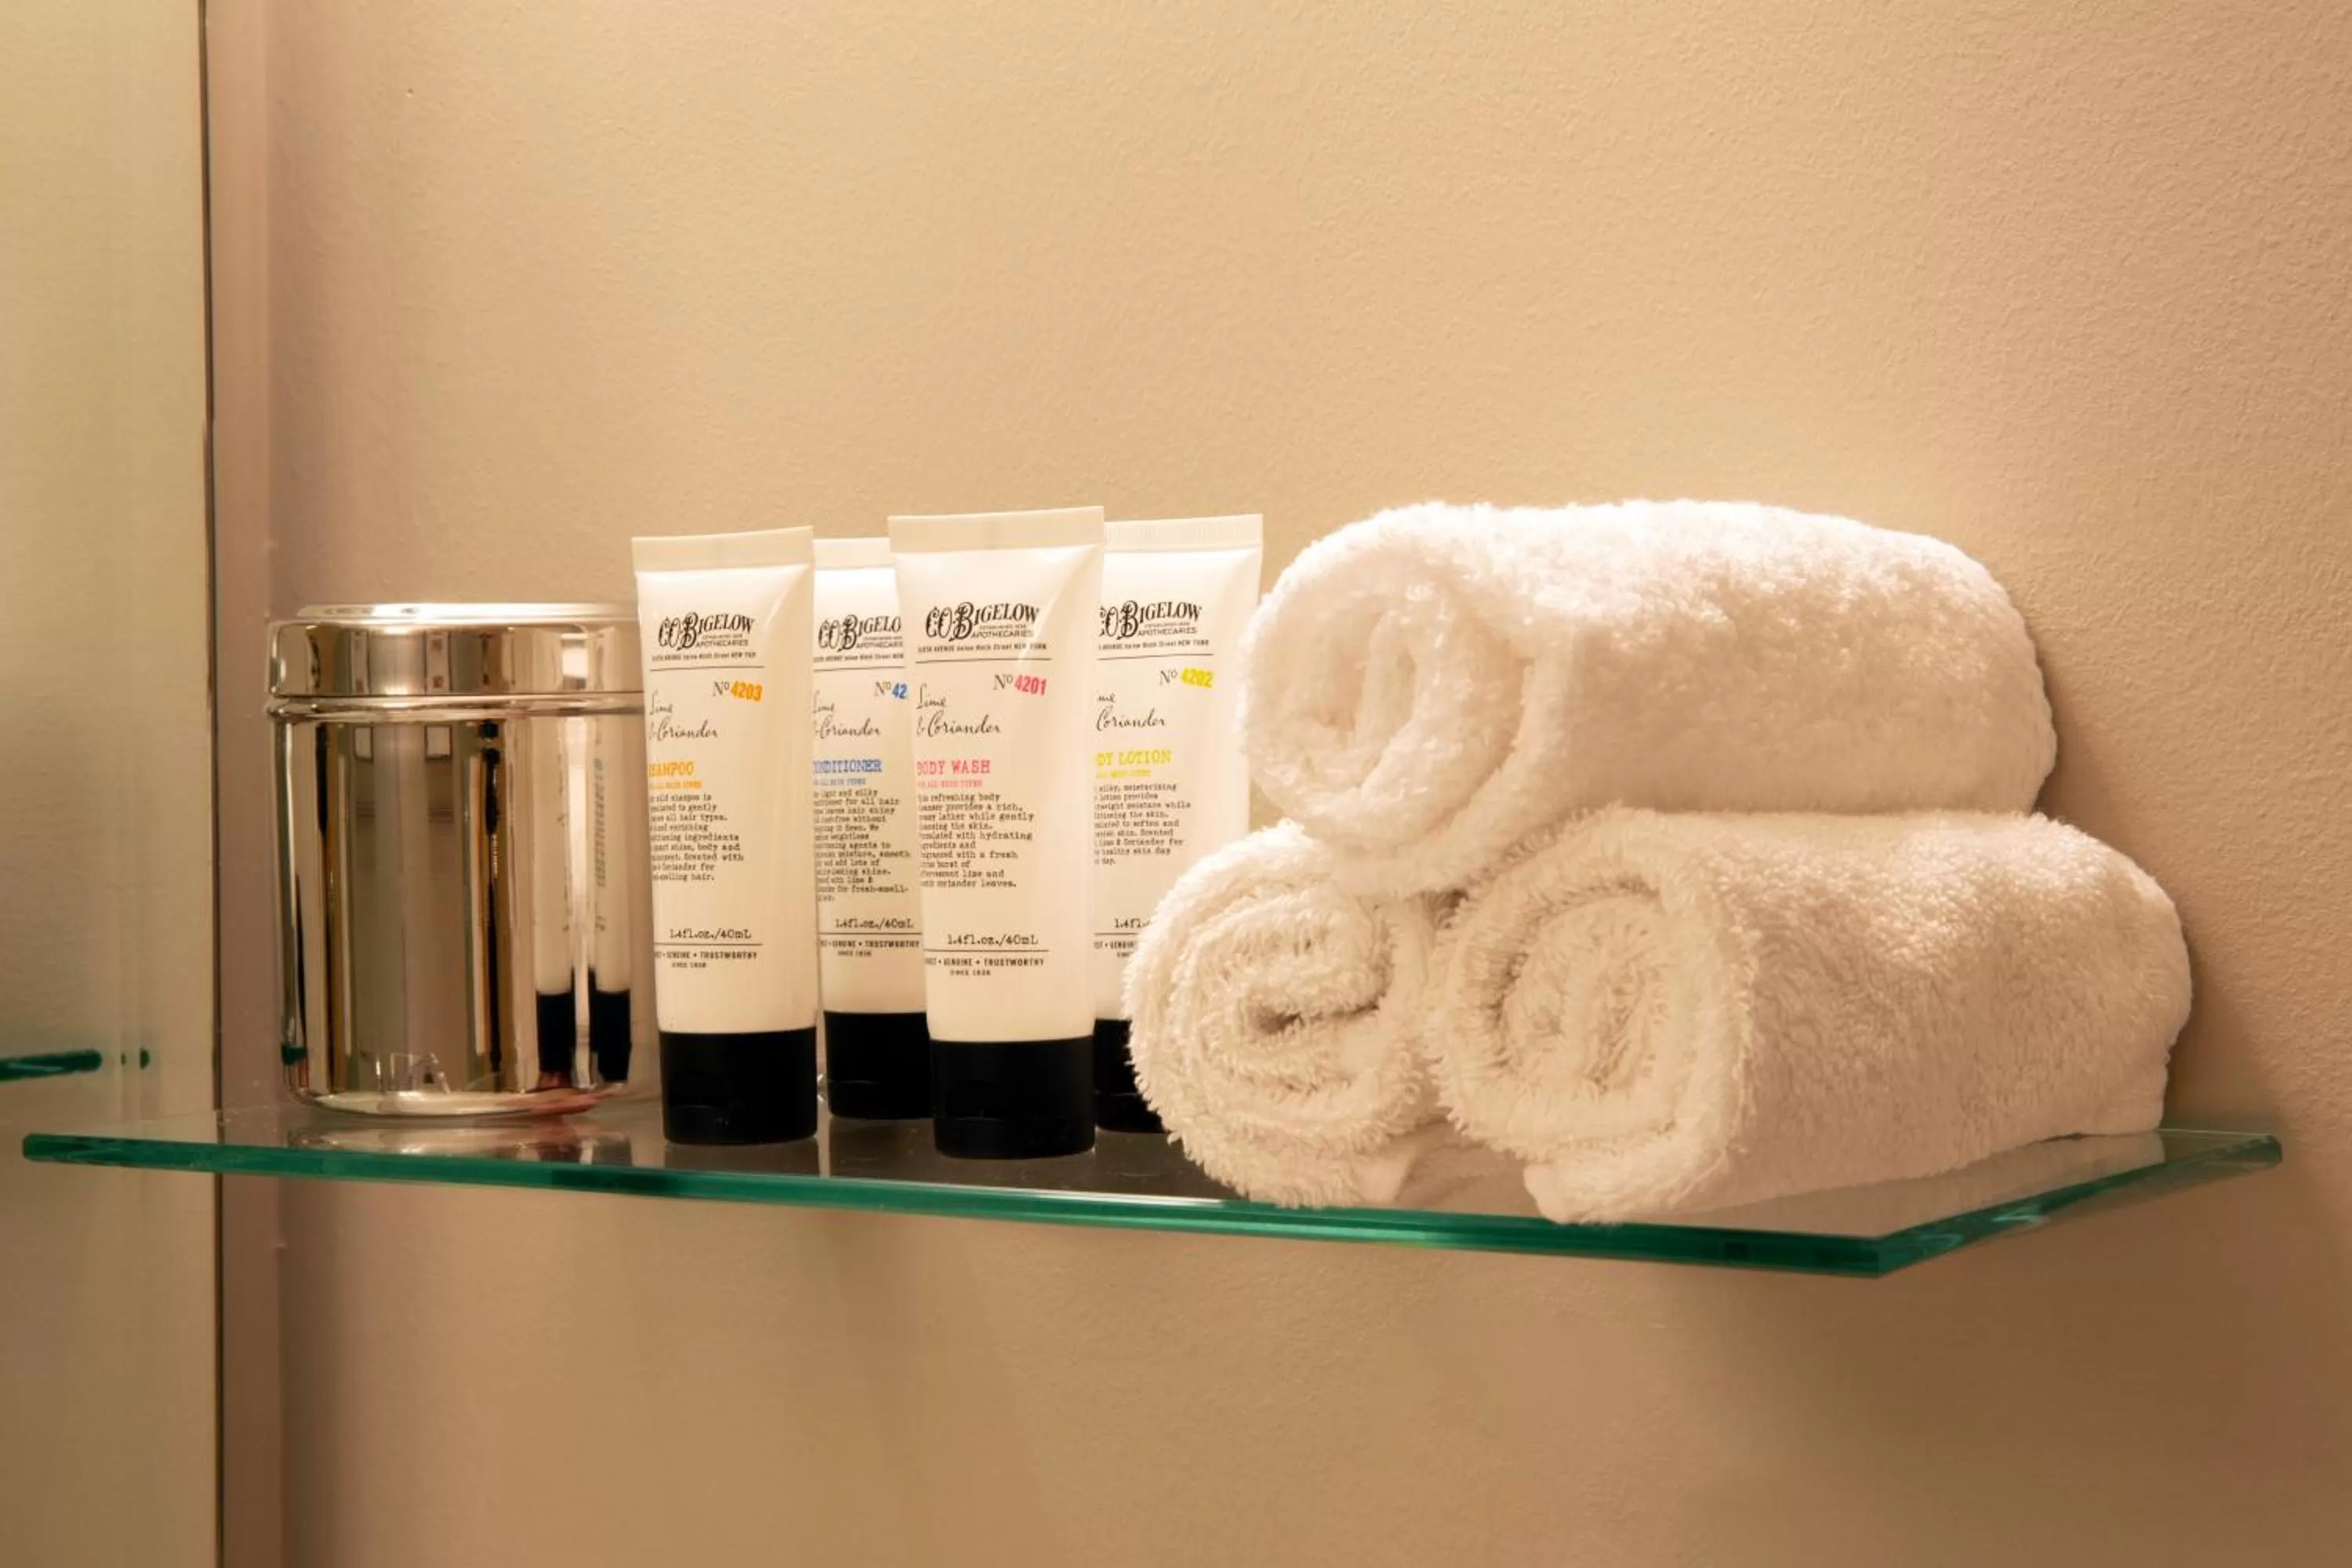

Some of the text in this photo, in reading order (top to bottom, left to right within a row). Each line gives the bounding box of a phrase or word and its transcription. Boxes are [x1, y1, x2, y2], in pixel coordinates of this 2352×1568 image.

[1138, 627, 1198, 637] APOTHECARIES
[696, 639, 749, 648] APOTHECARIES
[1015, 674, 1047, 695] 4201
[1181, 668, 1213, 688] 4202
[731, 681, 763, 701] 4203
[927, 710, 1001, 737] Coriander
[1097, 706, 1166, 731] Coriander
[658, 717, 717, 741] Coriander
[1119, 750, 1171, 765] LOTION
[952, 760, 991, 774] WASH
[1000, 813, 1034, 822] gently
[980, 832, 1033, 840] hydrating
